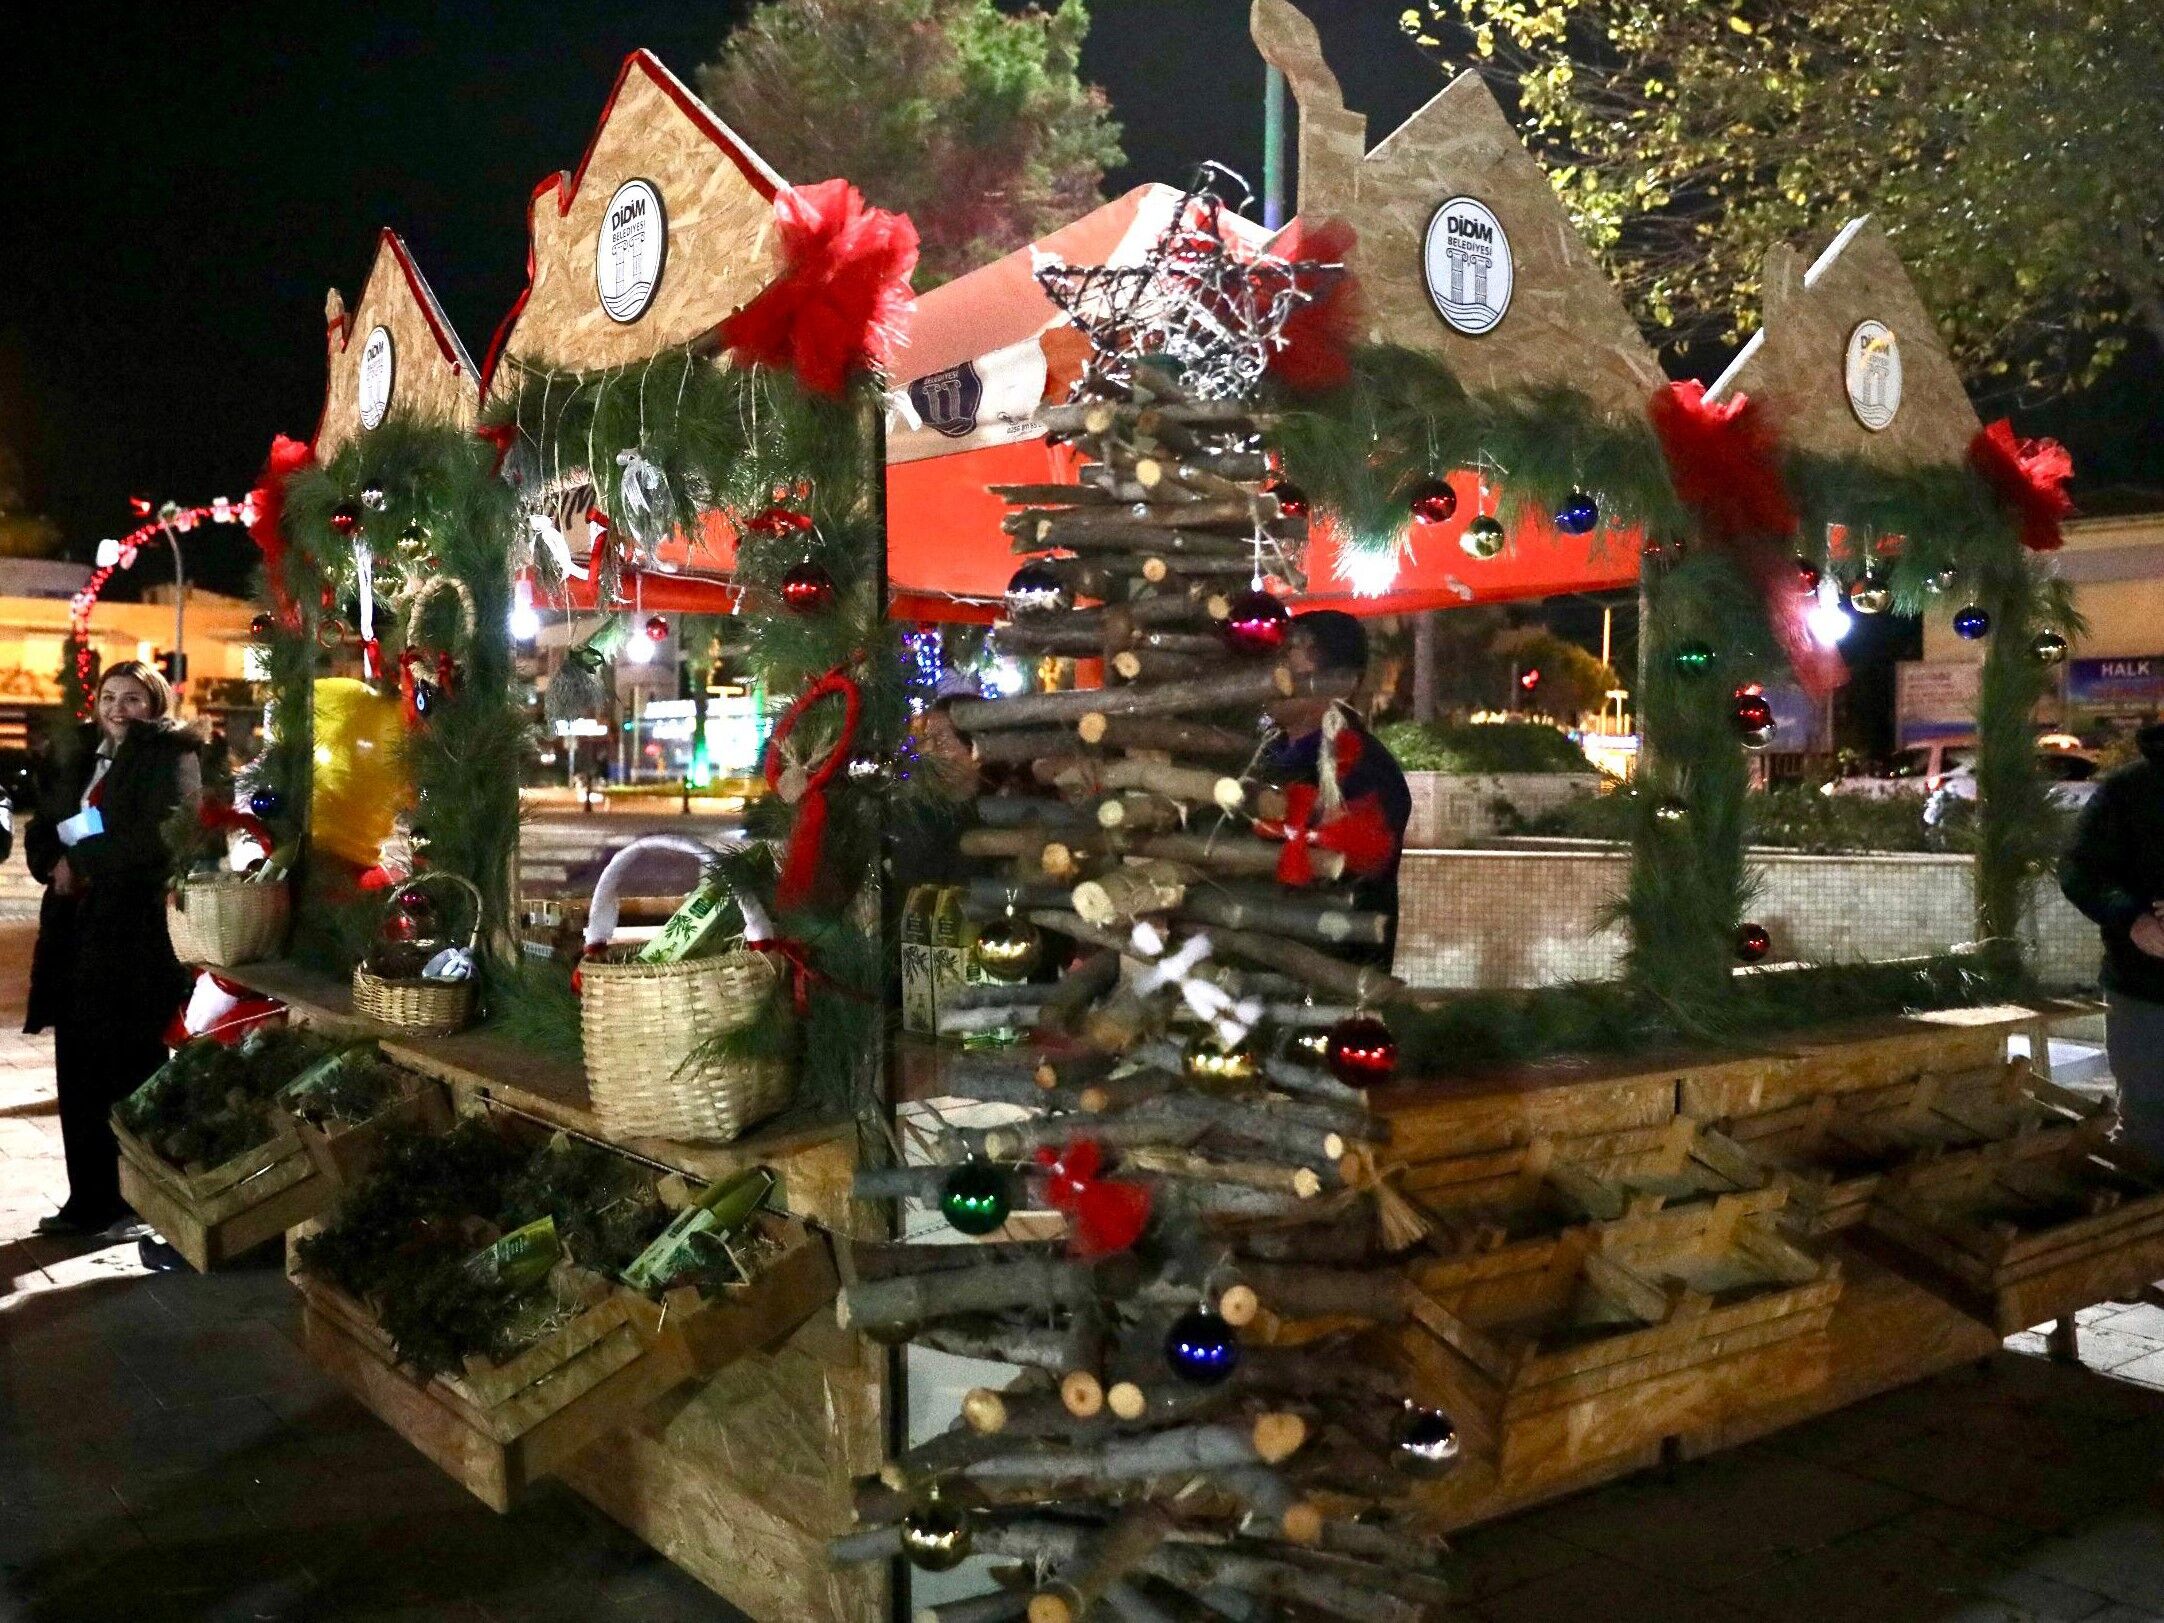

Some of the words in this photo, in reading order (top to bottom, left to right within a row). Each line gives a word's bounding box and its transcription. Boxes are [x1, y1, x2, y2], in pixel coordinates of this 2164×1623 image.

[611, 198, 646, 231] DİDİM
[1446, 213, 1493, 244] DİDİM
[2101, 661, 2150, 677] HALK
